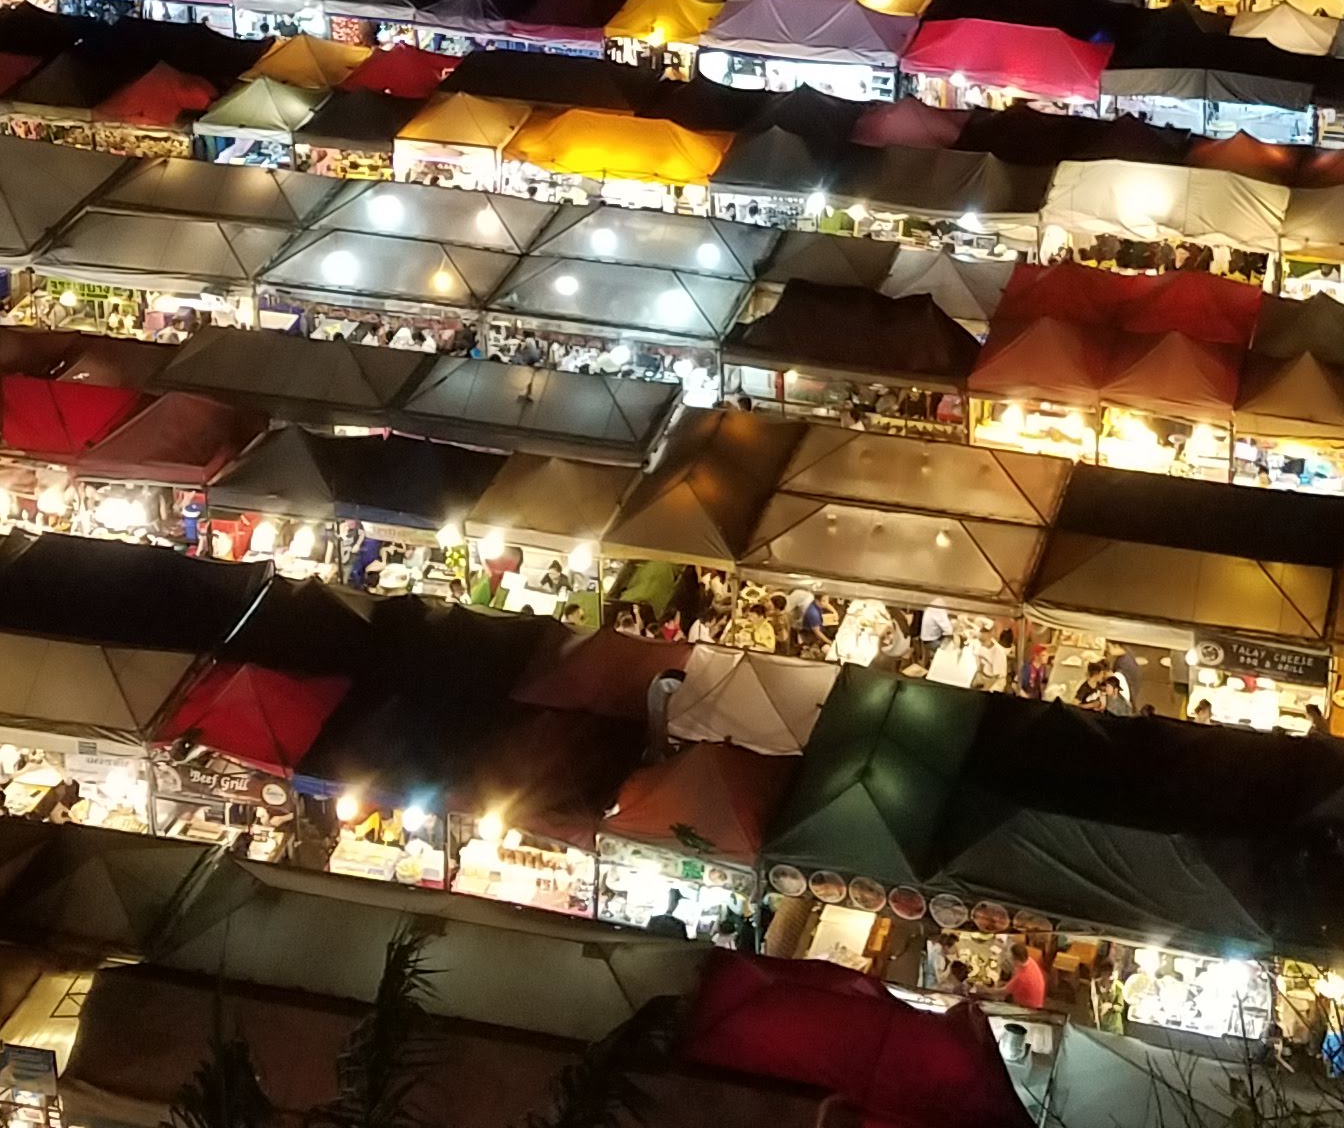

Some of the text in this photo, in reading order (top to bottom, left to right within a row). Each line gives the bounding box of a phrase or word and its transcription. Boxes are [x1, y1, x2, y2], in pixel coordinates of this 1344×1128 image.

[1231, 644, 1314, 667] TALAY CHEESE
[190, 769, 250, 792] Beef Grill
